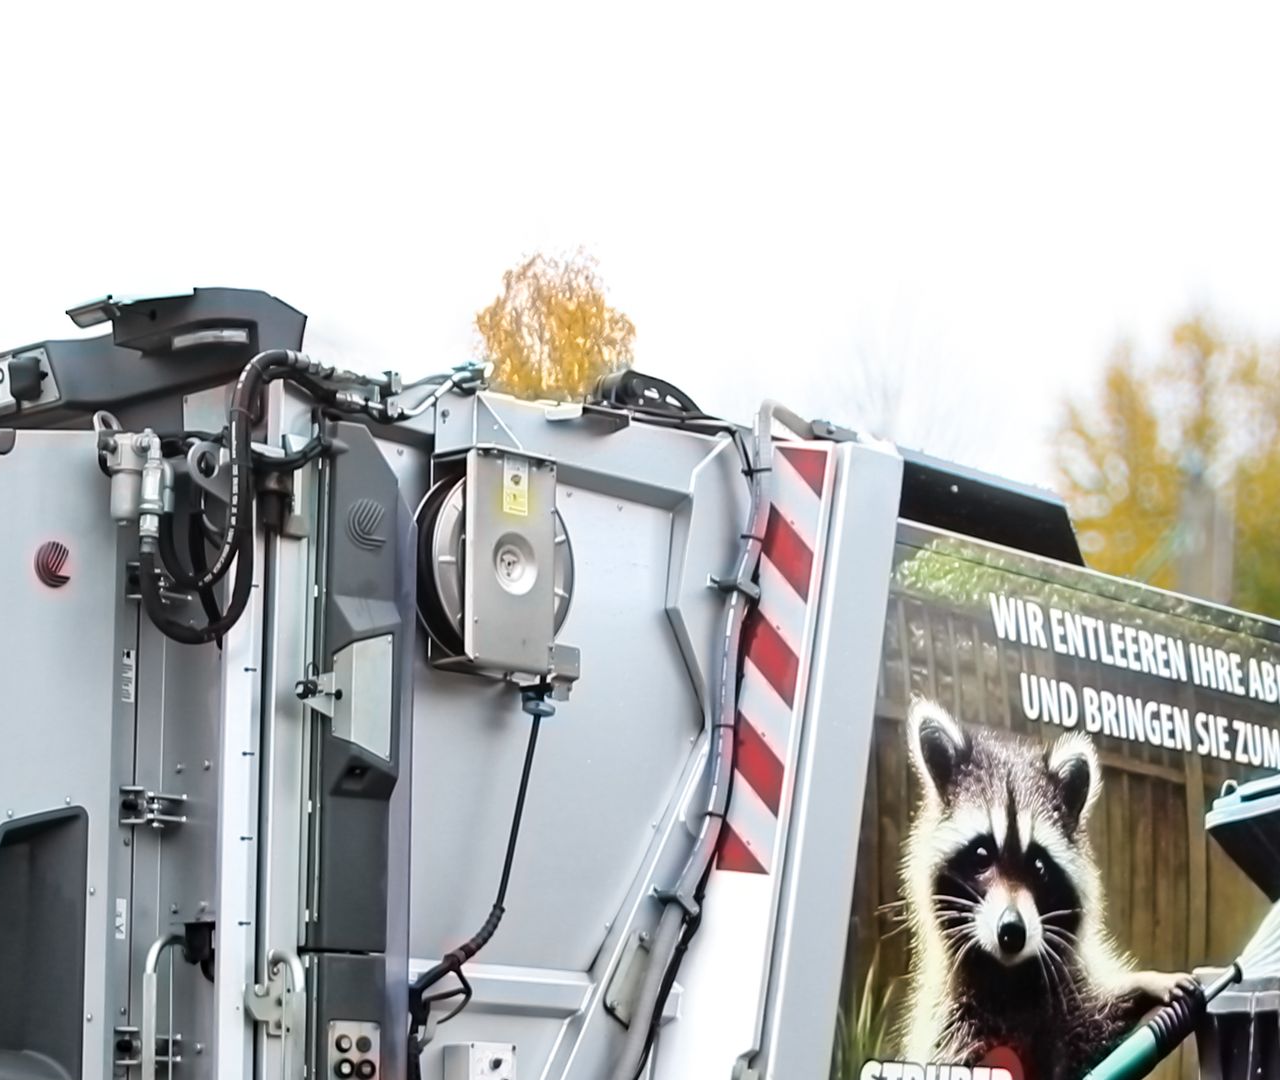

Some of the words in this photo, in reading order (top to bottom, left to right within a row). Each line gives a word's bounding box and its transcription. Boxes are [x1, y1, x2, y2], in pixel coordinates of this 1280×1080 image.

[988, 591, 1048, 649] WIR
[1049, 607, 1188, 682] ENTLEEREN
[1188, 642, 1246, 696] IHRE
[1020, 671, 1079, 728] UND
[1082, 686, 1192, 752] BRINGEN
[1194, 711, 1232, 760] SIE
